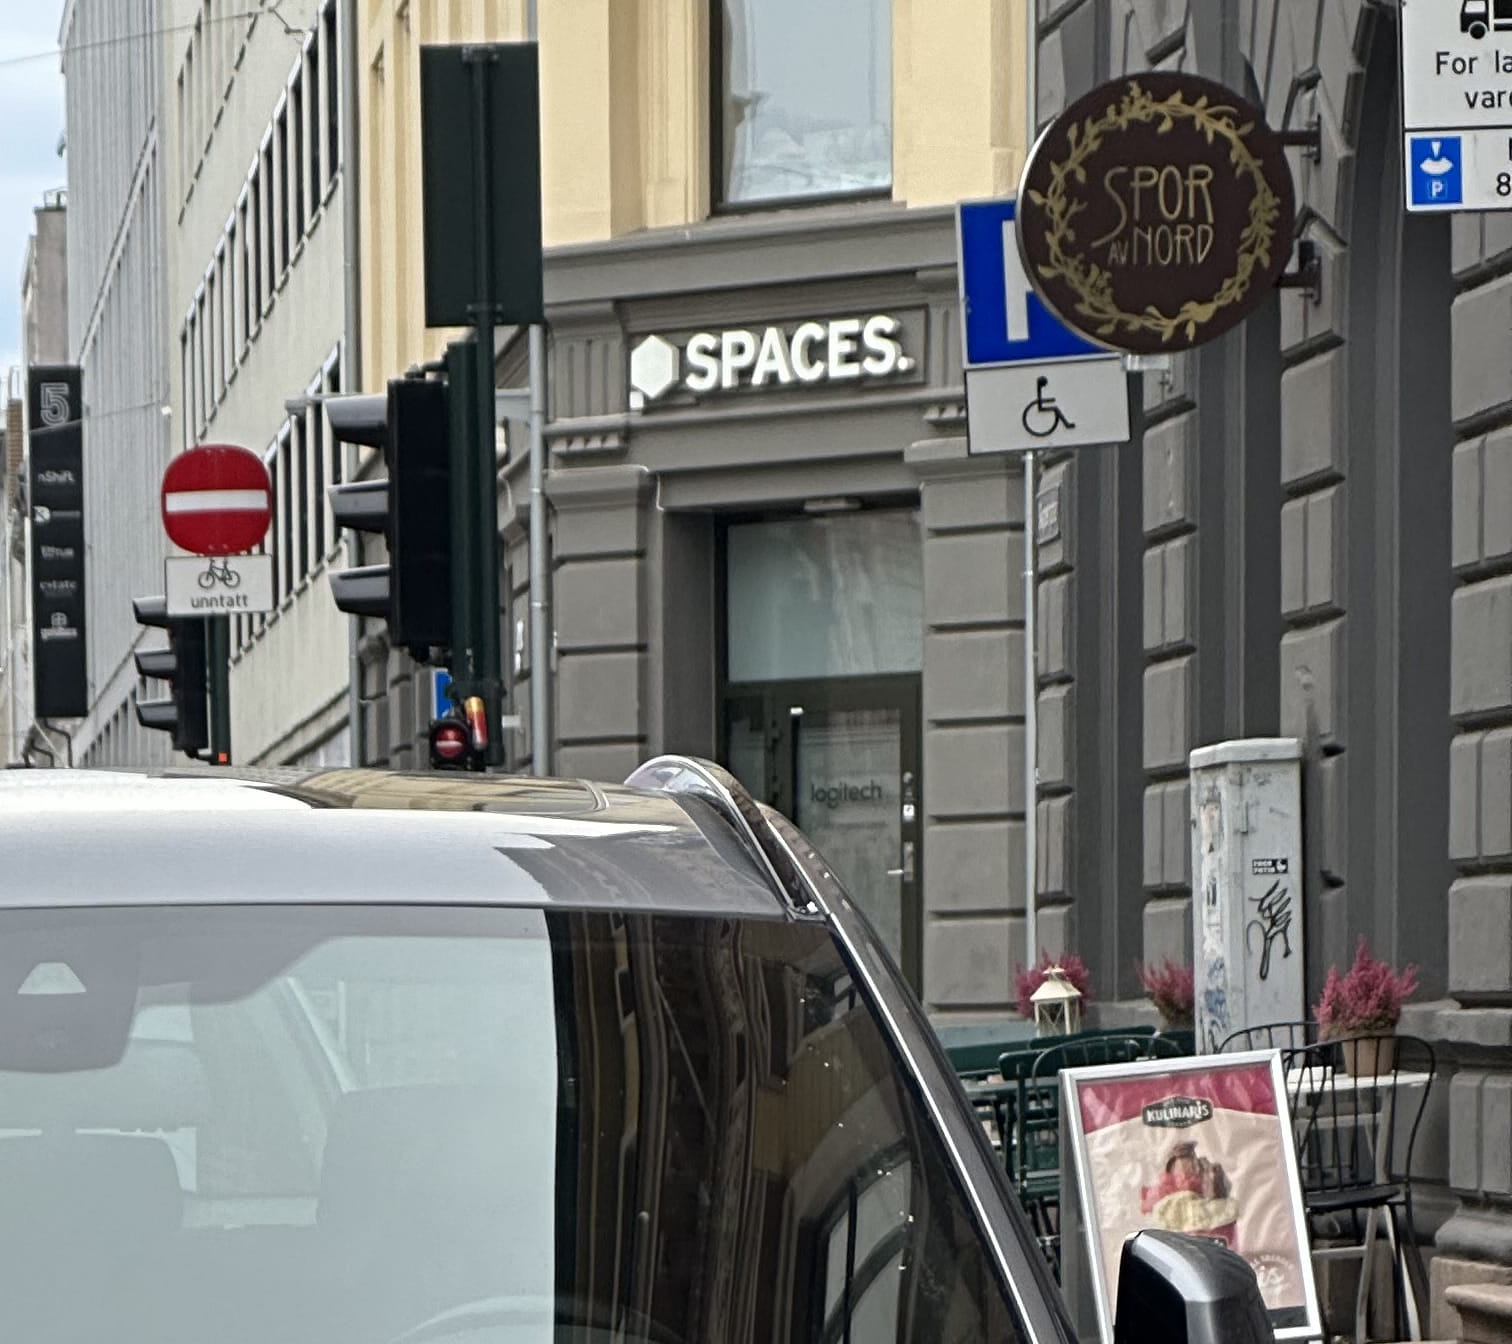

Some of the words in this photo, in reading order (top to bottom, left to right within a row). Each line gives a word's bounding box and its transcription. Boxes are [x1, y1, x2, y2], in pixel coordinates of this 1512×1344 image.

[1435, 51, 1479, 75] For
[1464, 89, 1512, 109] var
[1090, 164, 1215, 248] SPOR
[1132, 223, 1214, 265] NORD
[40, 382, 70, 427] 5
[191, 594, 248, 609] unntatt
[811, 780, 882, 809] logitech
